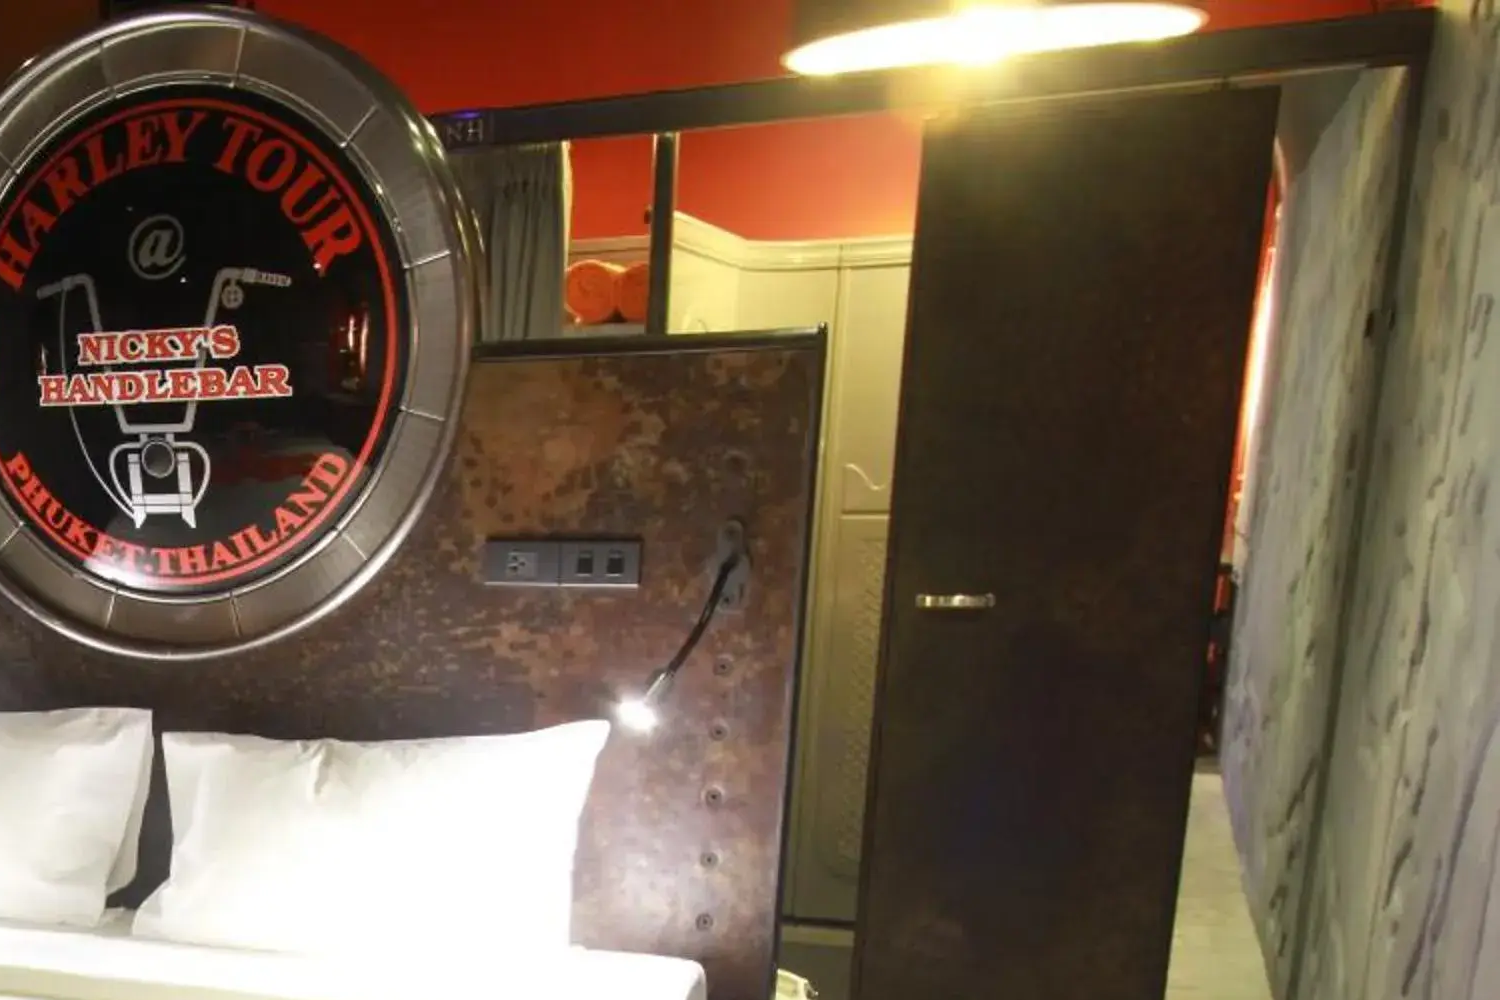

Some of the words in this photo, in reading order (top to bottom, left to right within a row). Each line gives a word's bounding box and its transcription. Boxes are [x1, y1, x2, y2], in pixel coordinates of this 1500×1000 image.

[213, 117, 361, 278] TOUR
[128, 213, 186, 280] @
[77, 325, 240, 365] NICKY'S
[38, 364, 293, 406] HANDLEBAR
